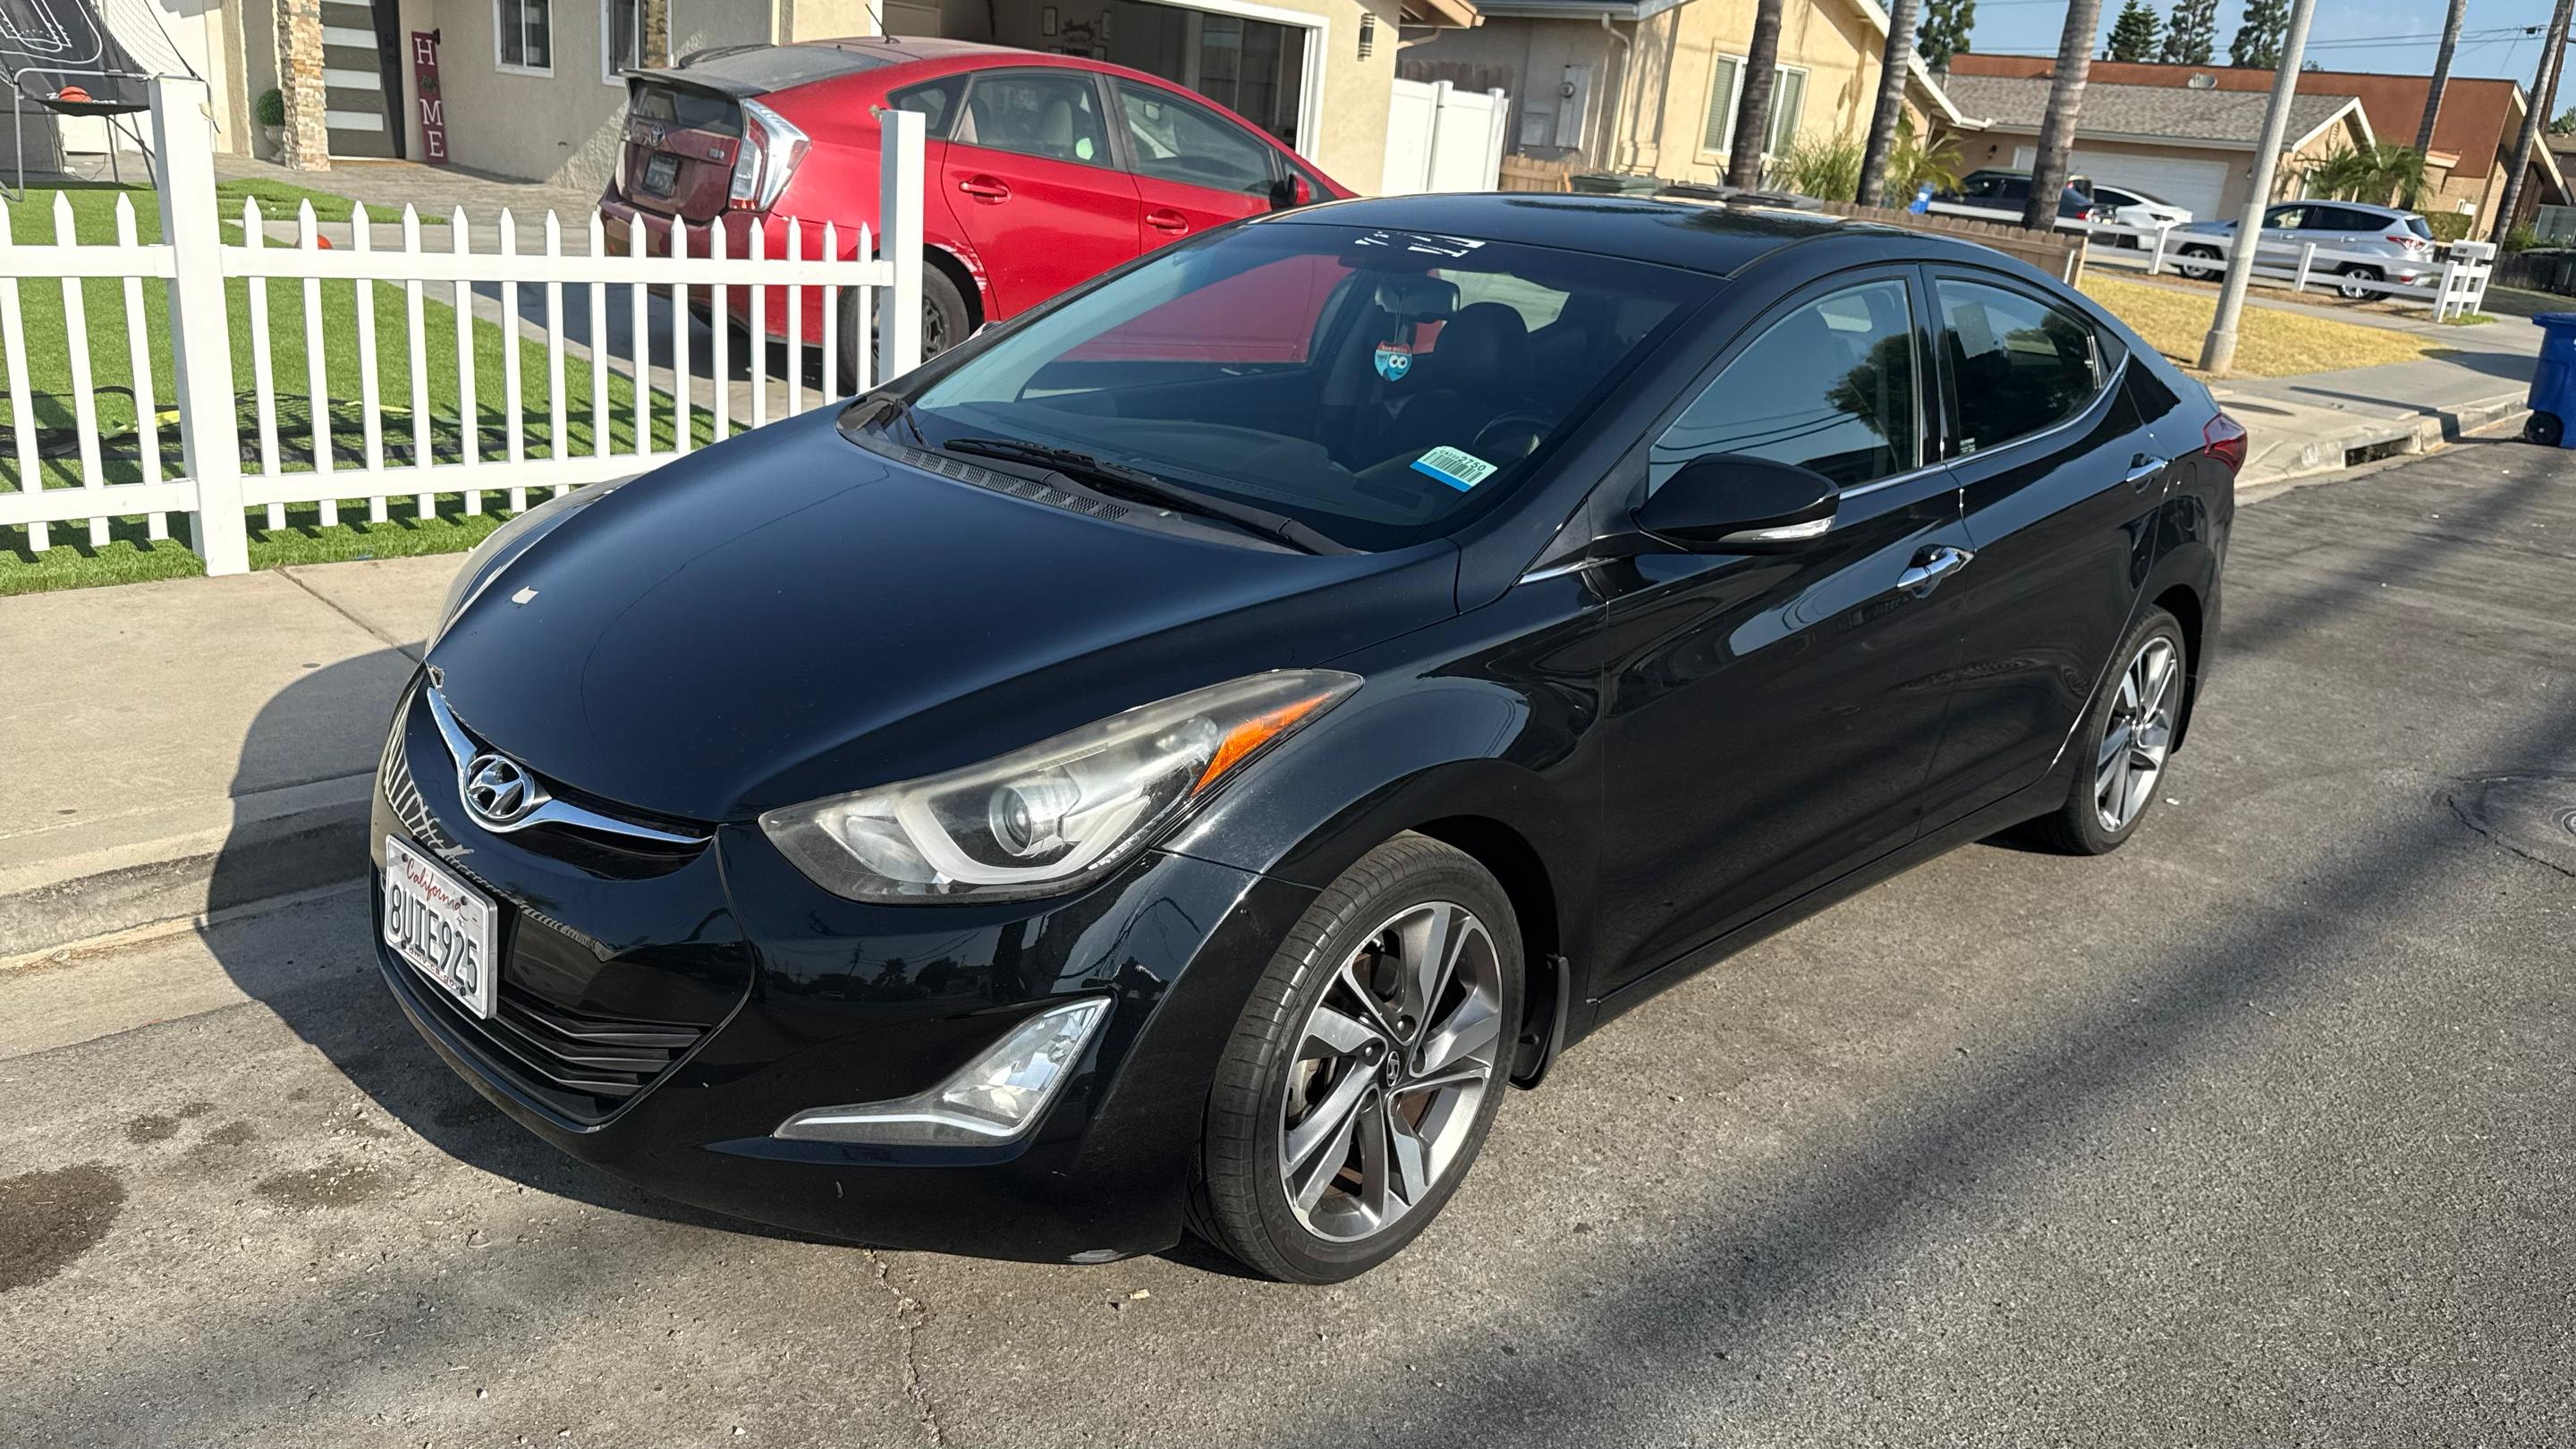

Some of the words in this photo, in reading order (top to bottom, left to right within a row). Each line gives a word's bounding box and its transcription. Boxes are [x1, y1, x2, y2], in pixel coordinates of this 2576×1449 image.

[415, 38, 444, 157] HME
[1458, 456, 1487, 471] 2750
[406, 859, 468, 921] California
[391, 885, 478, 995] 8UIE925
[409, 947, 460, 990] dmv.ca.gov
